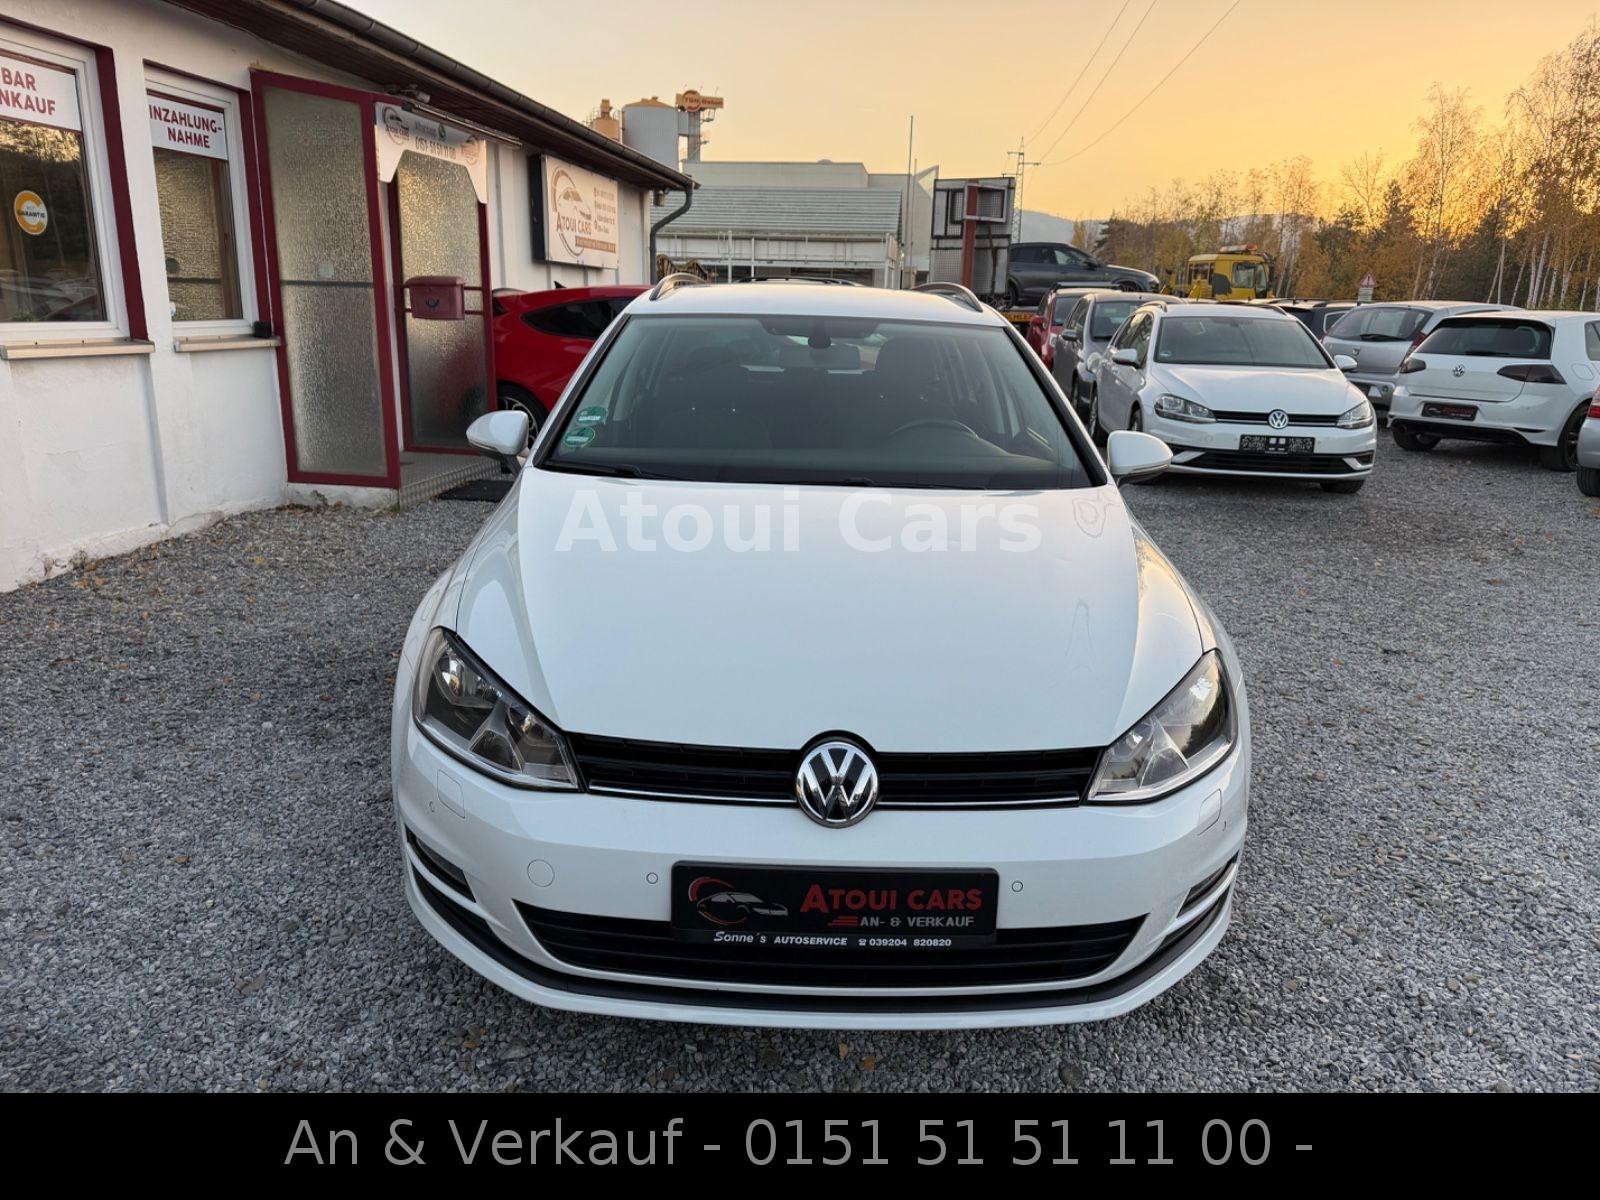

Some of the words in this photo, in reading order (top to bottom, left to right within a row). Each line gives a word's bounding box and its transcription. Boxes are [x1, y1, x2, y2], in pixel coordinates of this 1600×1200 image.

[1, 66, 37, 91] BAR
[167, 127, 210, 149] NAHME
[556, 211, 577, 234] ATOUI
[577, 219, 592, 236] CARS
[800, 884, 897, 913] ATOUI
[906, 889, 983, 911] CARS
[860, 916, 885, 927] AN-
[890, 916, 902, 927] &
[907, 916, 975, 928] VERKAUF
[774, 936, 848, 946] AUTOSERVICE
[869, 938, 908, 947] 039204
[913, 938, 952, 947] 820820
